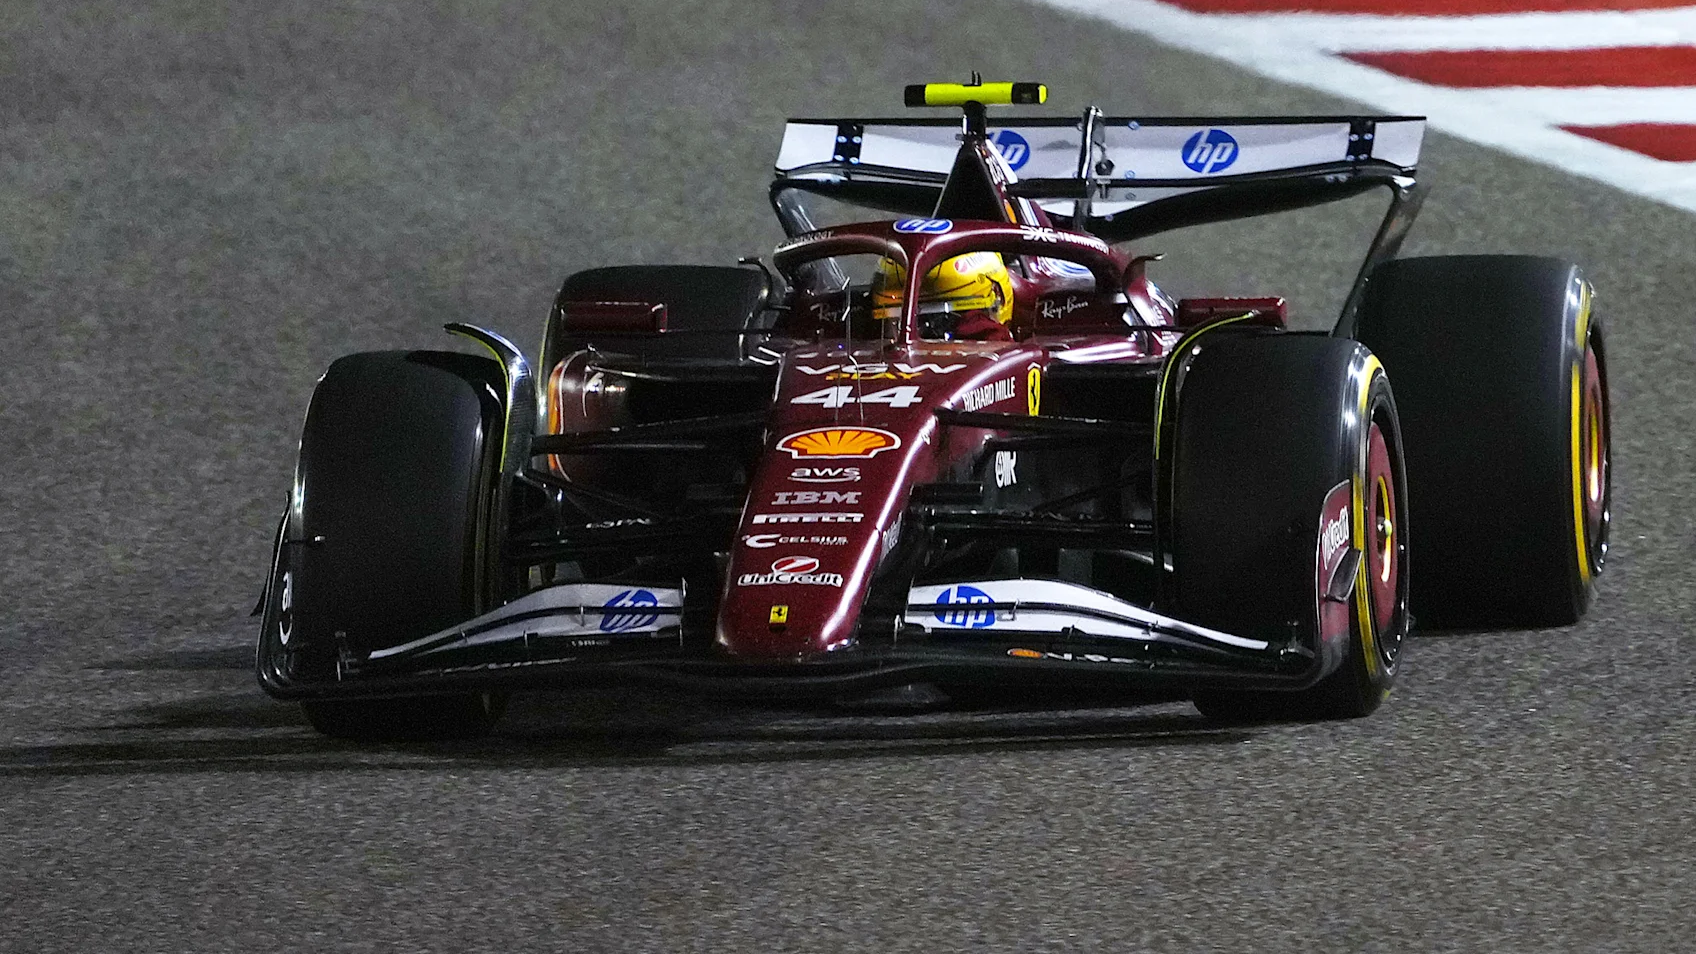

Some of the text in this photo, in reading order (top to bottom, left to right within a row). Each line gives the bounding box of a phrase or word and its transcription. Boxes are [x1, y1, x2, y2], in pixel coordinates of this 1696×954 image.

[1186, 129, 1235, 174] hp
[1041, 296, 1089, 319] Ray-Ban
[795, 362, 968, 375] VGW
[790, 385, 923, 408] 44
[961, 376, 1016, 412] RICHARD MILLE
[790, 467, 861, 478] aws
[771, 491, 862, 506] IBM
[752, 512, 865, 525] PIRELLI
[737, 573, 844, 588] UniCredit
[602, 589, 657, 632] hp
[942, 586, 990, 628] hp
